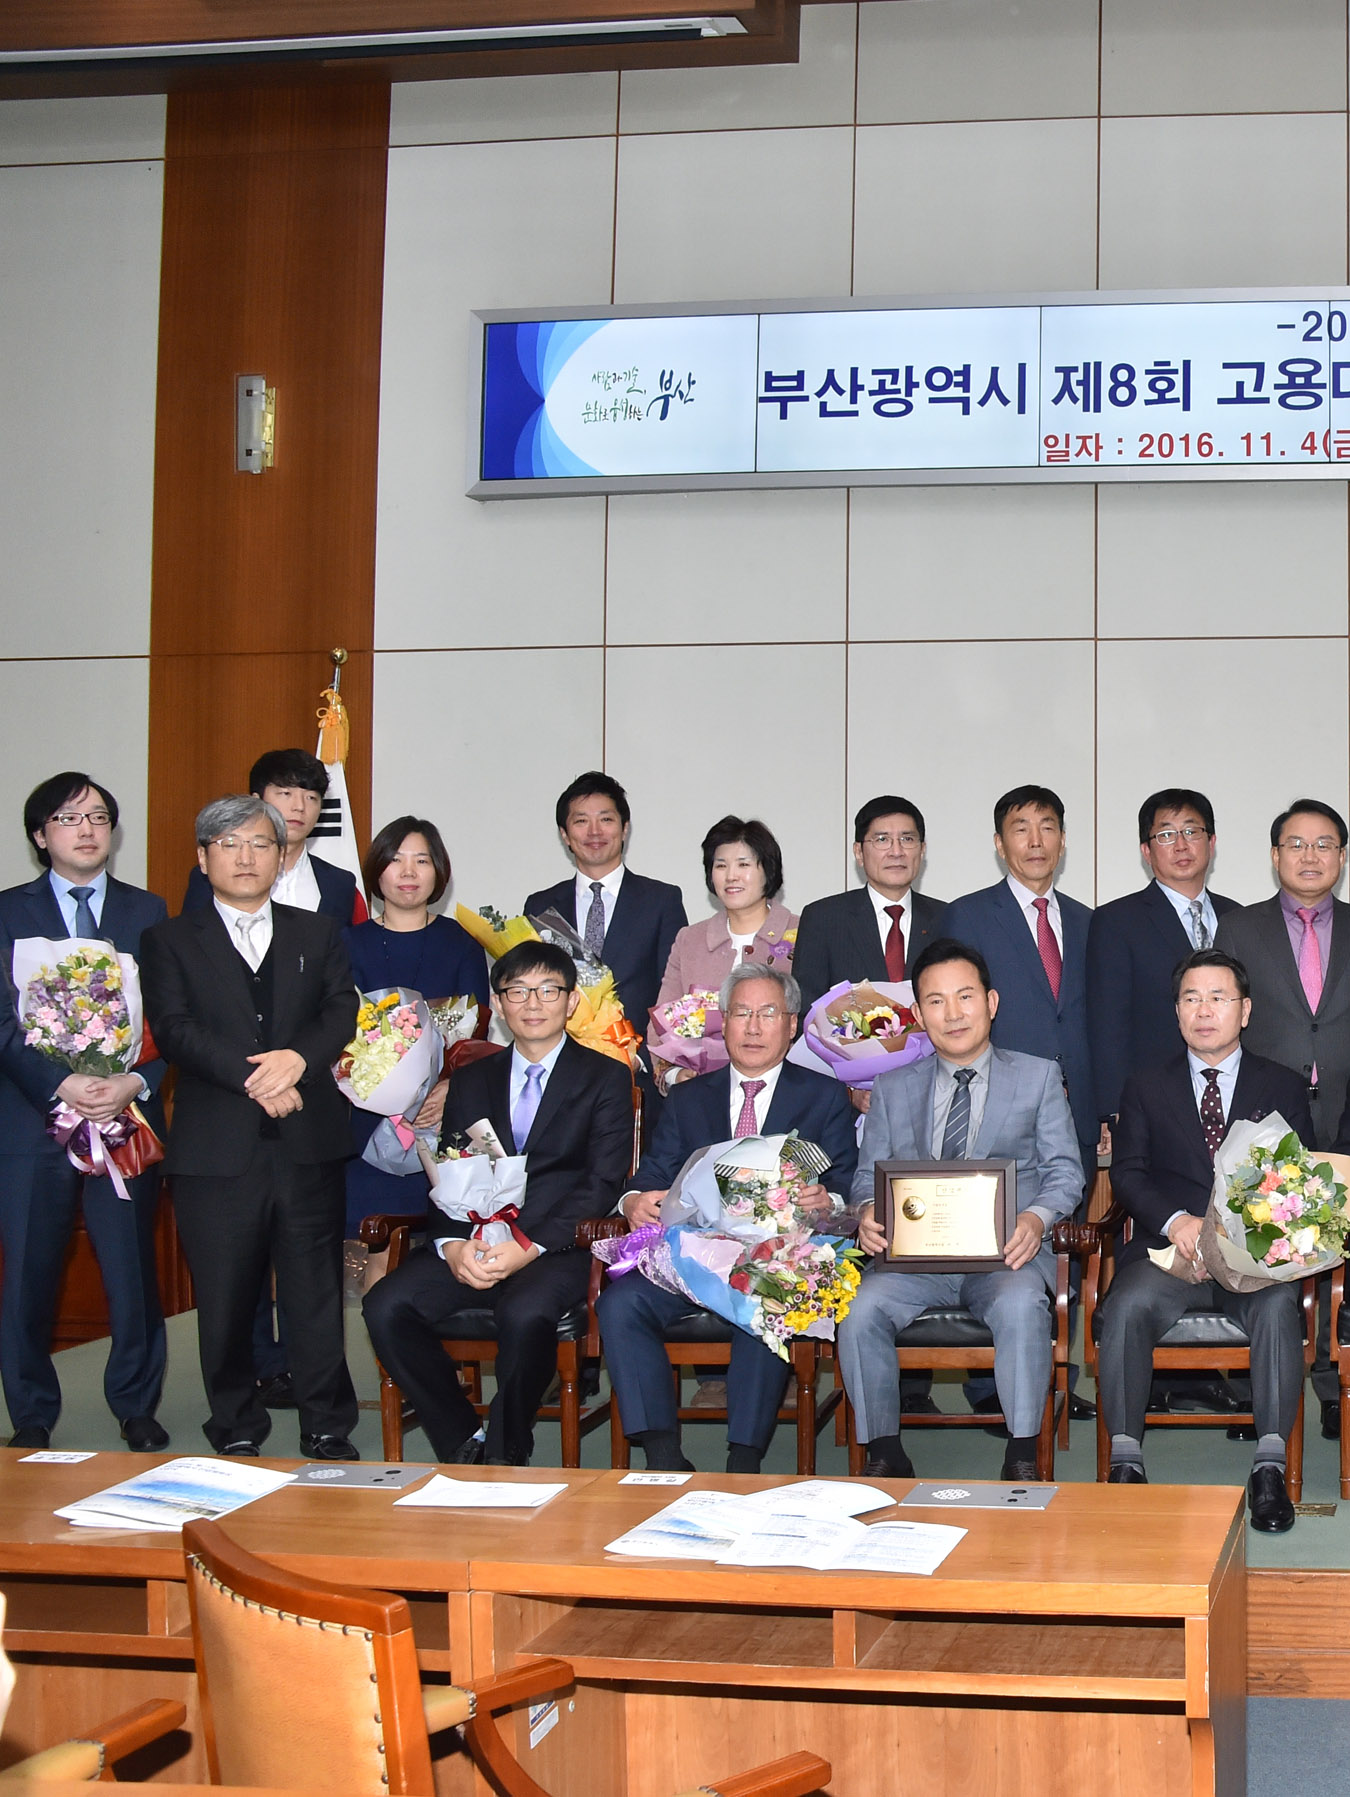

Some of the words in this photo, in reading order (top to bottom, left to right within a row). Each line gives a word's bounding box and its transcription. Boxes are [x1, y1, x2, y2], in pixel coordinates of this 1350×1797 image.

[646, 368, 697, 421] 부산
[758, 362, 1027, 420] 부산광역시
[1052, 359, 1192, 414] 제8회
[1043, 433, 1103, 463] 일자
[1138, 432, 1224, 458] 2016.
[1241, 432, 1286, 457] 11.
